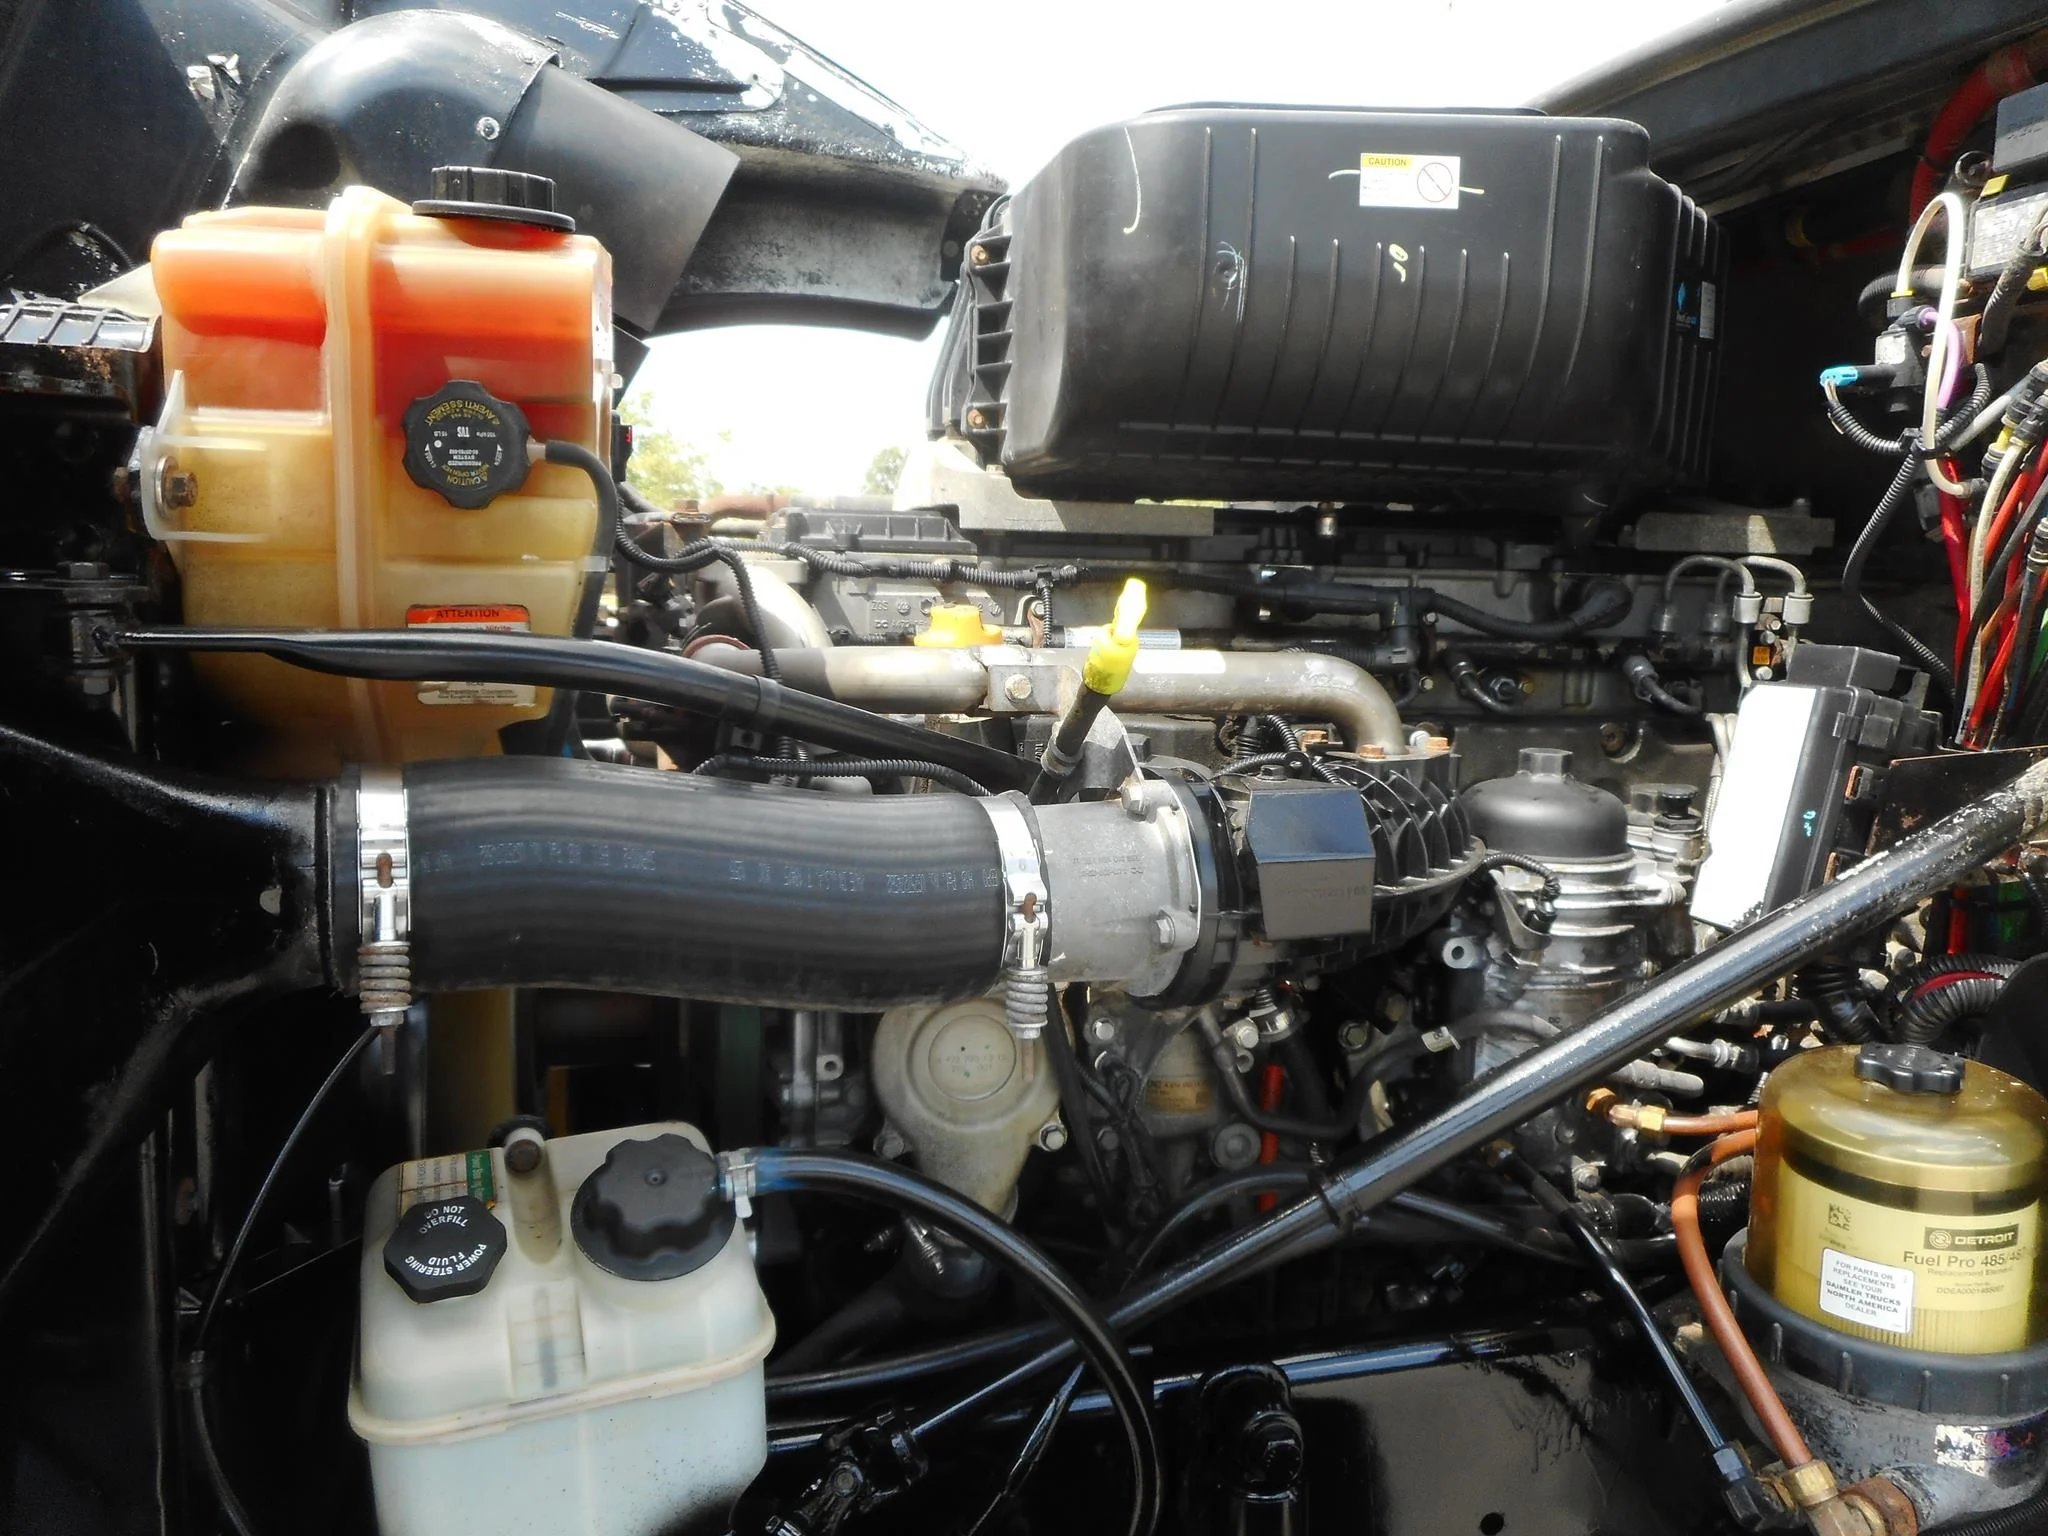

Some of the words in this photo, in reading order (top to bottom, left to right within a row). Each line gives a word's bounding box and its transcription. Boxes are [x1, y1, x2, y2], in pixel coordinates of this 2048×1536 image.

[1368, 157, 1407, 167] CAUTION
[457, 426, 470, 438] TVS
[447, 476, 481, 486] CAUTION
[437, 608, 500, 618] ATTENTION
[425, 1208, 439, 1219] DO
[443, 1205, 465, 1214] NOT
[419, 1215, 469, 1234] OVERFILL
[1955, 1232, 2015, 1246] DETROIT
[428, 1252, 466, 1266] FLUID
[457, 1243, 487, 1272] POWER
[1903, 1250, 1941, 1266] Fuel
[1947, 1255, 1976, 1268] Pro
[405, 1256, 453, 1276] STEERING
[1836, 1260, 1851, 1269] FOR
[1853, 1265, 1879, 1277] PARTS
[1881, 1273, 1893, 1281] OR
[1832, 1267, 1896, 1289] REPLACEMENTS
[1843, 1278, 1858, 1287] SEE
[1861, 1283, 1883, 1294] YOUR
[1826, 1280, 1862, 1296] DAIMLER
[1865, 1292, 1902, 1306] TRUCKS
[1827, 1288, 1856, 1302] NORTH
[1858, 1300, 1899, 1313] AMERICA
[1845, 1302, 1877, 1316] DEALER
